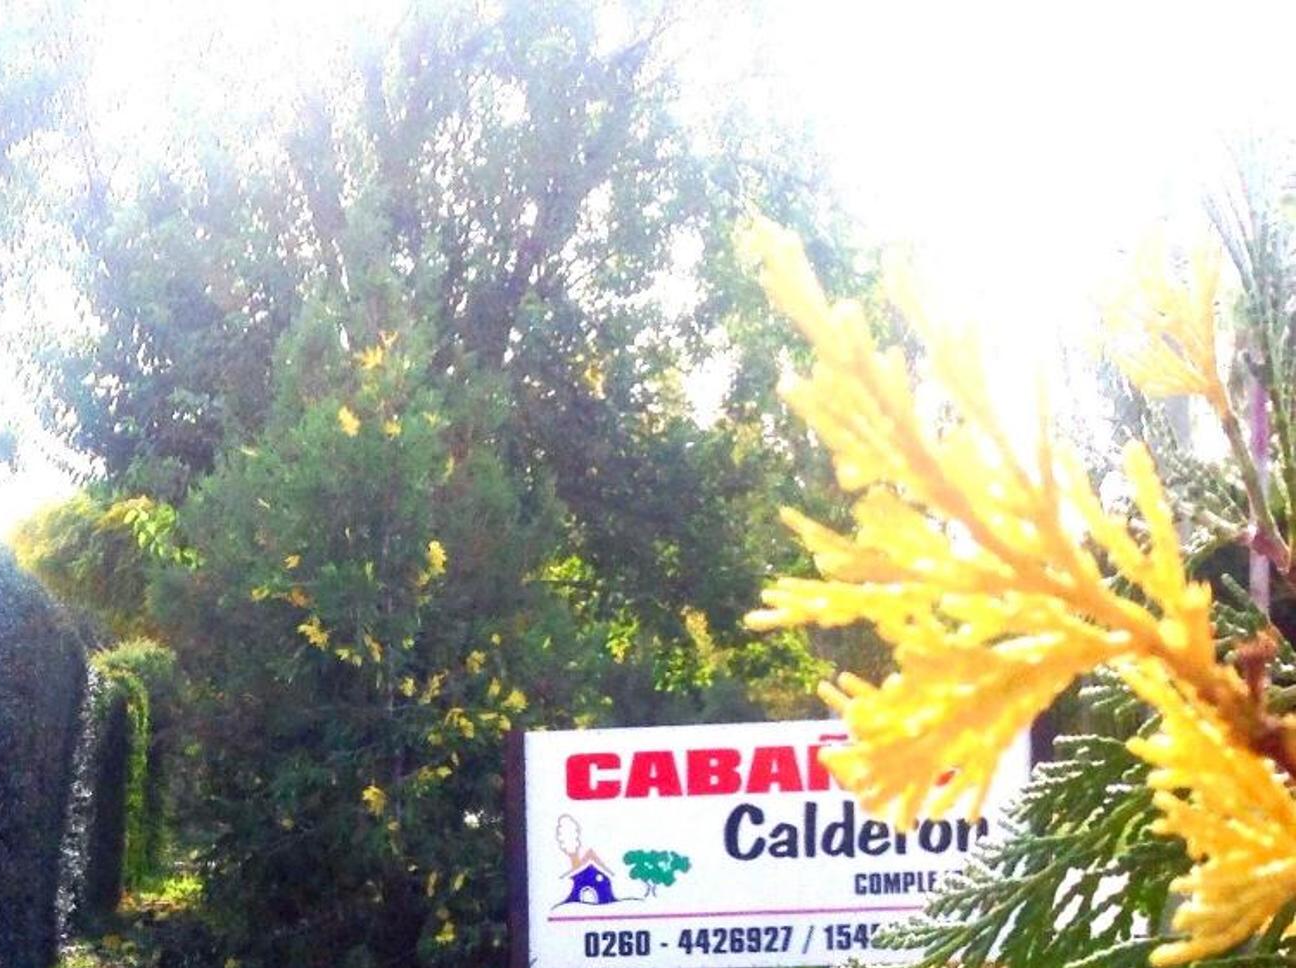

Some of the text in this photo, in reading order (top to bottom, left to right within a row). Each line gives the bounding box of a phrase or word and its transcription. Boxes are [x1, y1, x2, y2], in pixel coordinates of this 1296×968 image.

[566, 734, 956, 800] CABA
[855, 871, 964, 895] COMPLE
[585, 930, 650, 957] 0260
[678, 925, 793, 954] 4426927
